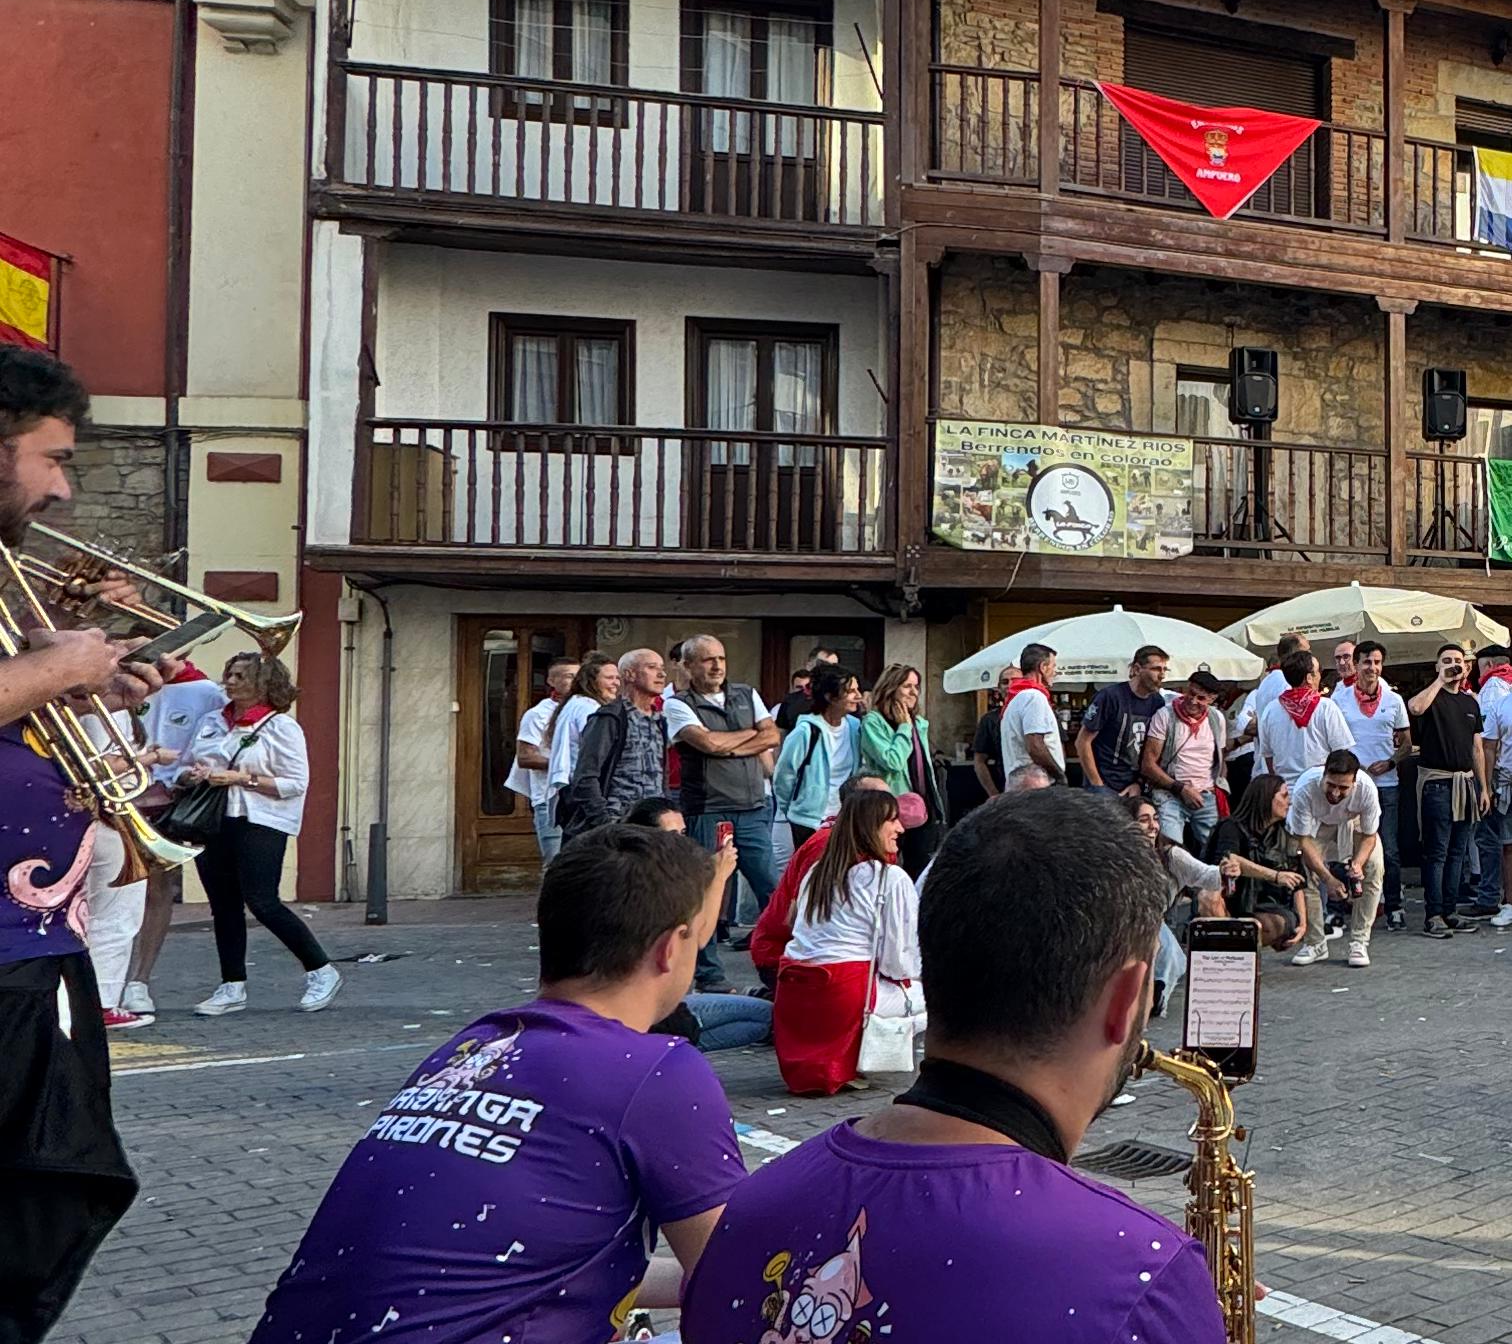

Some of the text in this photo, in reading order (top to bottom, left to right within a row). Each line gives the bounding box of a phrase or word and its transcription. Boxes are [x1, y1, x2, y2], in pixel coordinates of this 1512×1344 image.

[946, 425, 972, 436] LA
[978, 427, 1036, 439] FINCA
[1070, 451, 1094, 460] en
[383, 1087, 544, 1133] ARANGA
